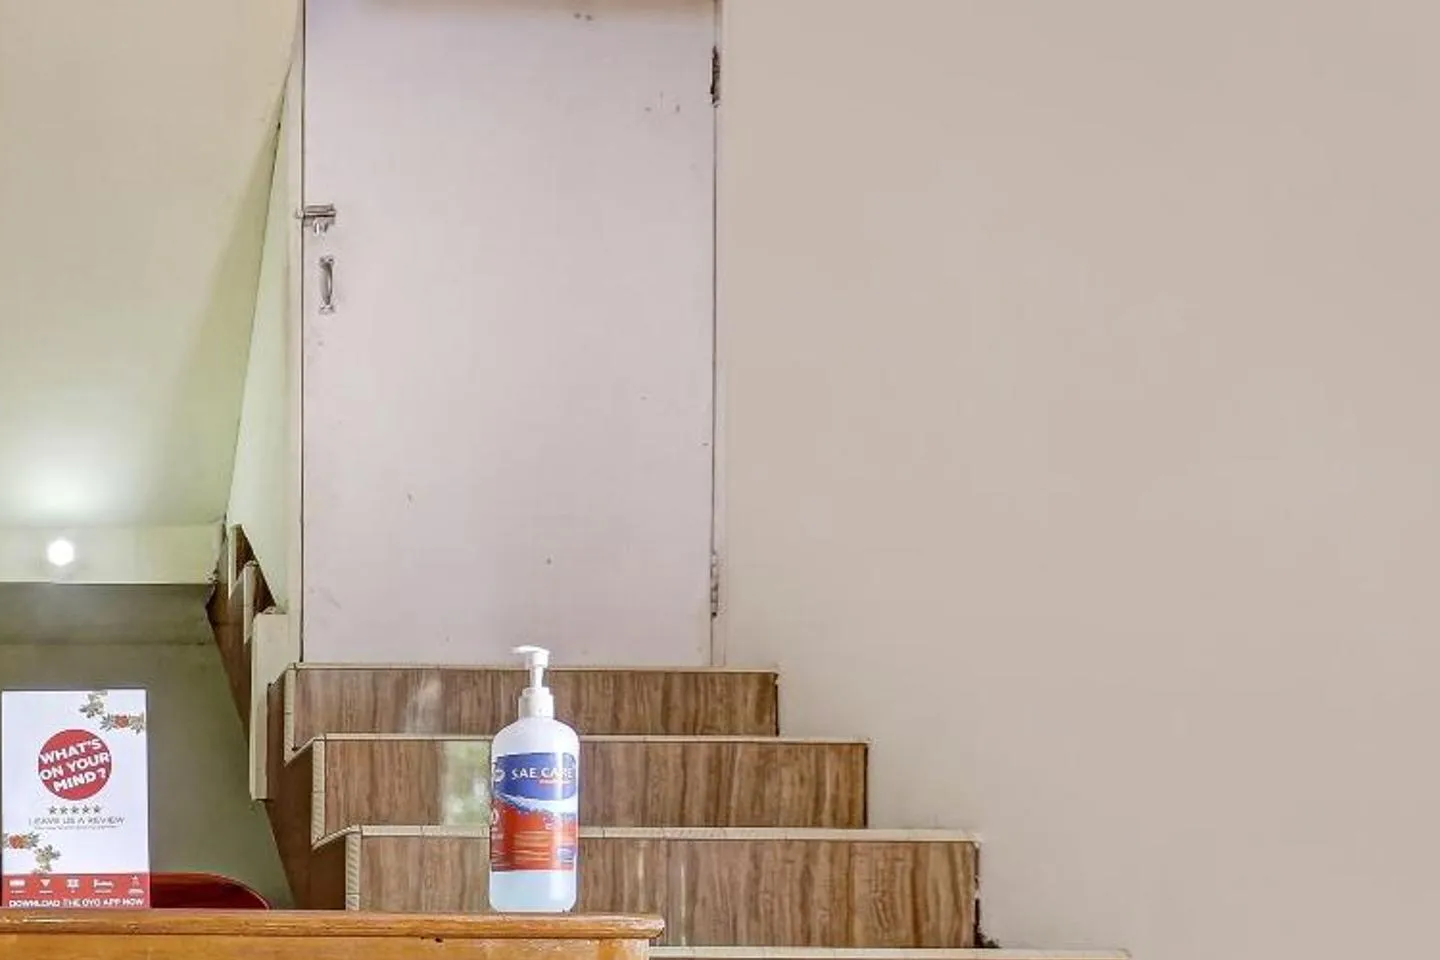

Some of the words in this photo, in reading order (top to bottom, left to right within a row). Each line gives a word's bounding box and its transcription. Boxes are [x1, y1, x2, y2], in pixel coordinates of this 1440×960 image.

[40, 738, 101, 764] WHAT'S
[40, 766, 64, 780] ON
[66, 753, 110, 772] YOUR
[511, 767, 536, 780] SAE
[9, 899, 61, 908] DOWNLOAD
[103, 898, 121, 906] APP
